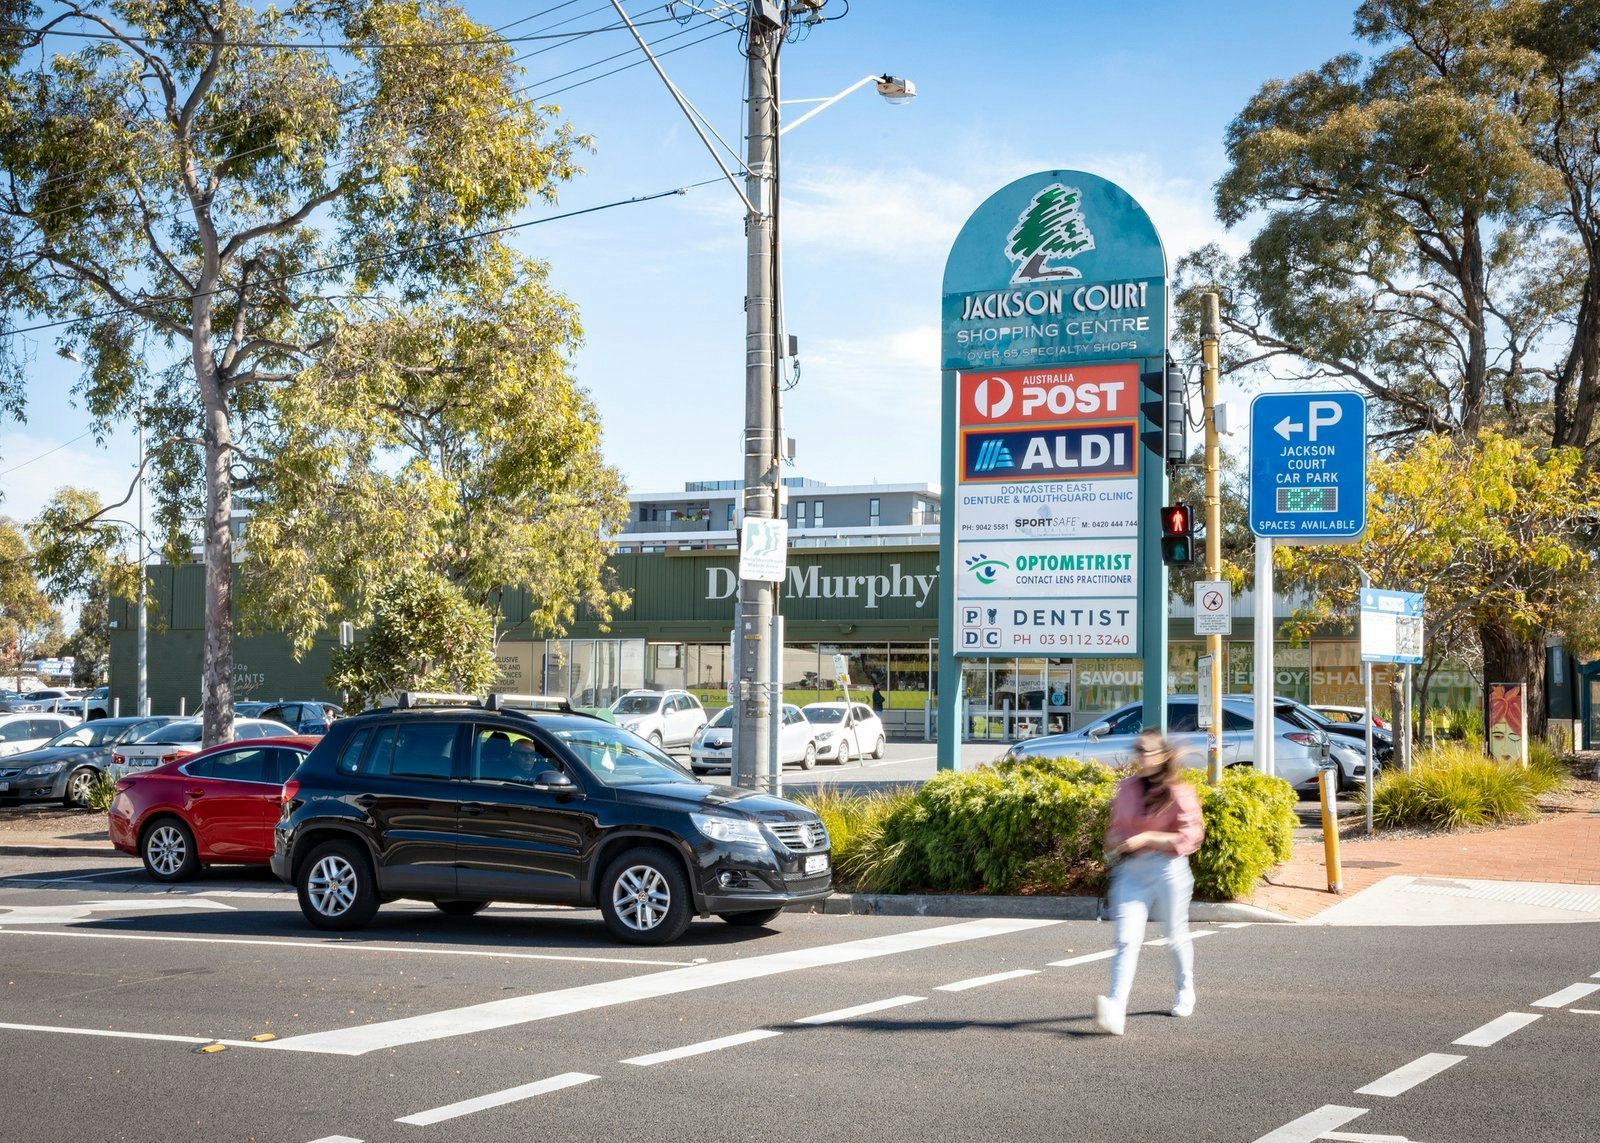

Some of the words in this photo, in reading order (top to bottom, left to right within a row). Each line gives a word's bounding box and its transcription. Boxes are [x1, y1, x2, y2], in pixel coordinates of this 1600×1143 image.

[961, 288, 1062, 320] JACKSON
[1073, 282, 1148, 313] COURT
[957, 323, 1059, 343] SHOPPING
[1066, 316, 1150, 335] CENTRE
[967, 350, 1000, 361] OVER
[1003, 348, 1018, 358] 65
[1022, 344, 1090, 357] SPECIALTY
[1093, 340, 1137, 352] SHOPS
[1023, 373, 1075, 385] AUSTRALIA
[1022, 382, 1125, 416] POST
[1308, 400, 1343, 442] P
[1021, 433, 1125, 470] ALDI
[1280, 445, 1335, 457] JACKSON
[1288, 459, 1327, 470] COURT
[1276, 473, 1300, 483] CAR
[1306, 472, 1338, 483] PARK
[1001, 485, 1064, 495] DONCASTER
[1067, 483, 1093, 492] EAST
[963, 496, 1010, 505] DENTURE
[1013, 495, 1020, 504] &
[1023, 493, 1097, 504] MOUTHGUARD
[1100, 491, 1134, 501] CLINIC
[1287, 488, 1323, 511] 82
[993, 523, 1009, 531] 5581
[1259, 521, 1295, 529] SPACES
[1300, 520, 1355, 529] AVAILABLE
[1016, 554, 1132, 571] OPTOMETRIST
[1016, 576, 1053, 585] CONTACT
[1056, 576, 1074, 584] LENS
[1077, 575, 1132, 584] PRACTITIONER
[966, 610, 978, 623] P
[1013, 610, 1130, 626] DENTIST
[1013, 634, 1031, 645] PH
[1039, 634, 1056, 645] 03
[1060, 635, 1092, 645] 9112
[1096, 634, 1130, 645] 3240
[1080, 663, 1124, 671] SPIRITS
